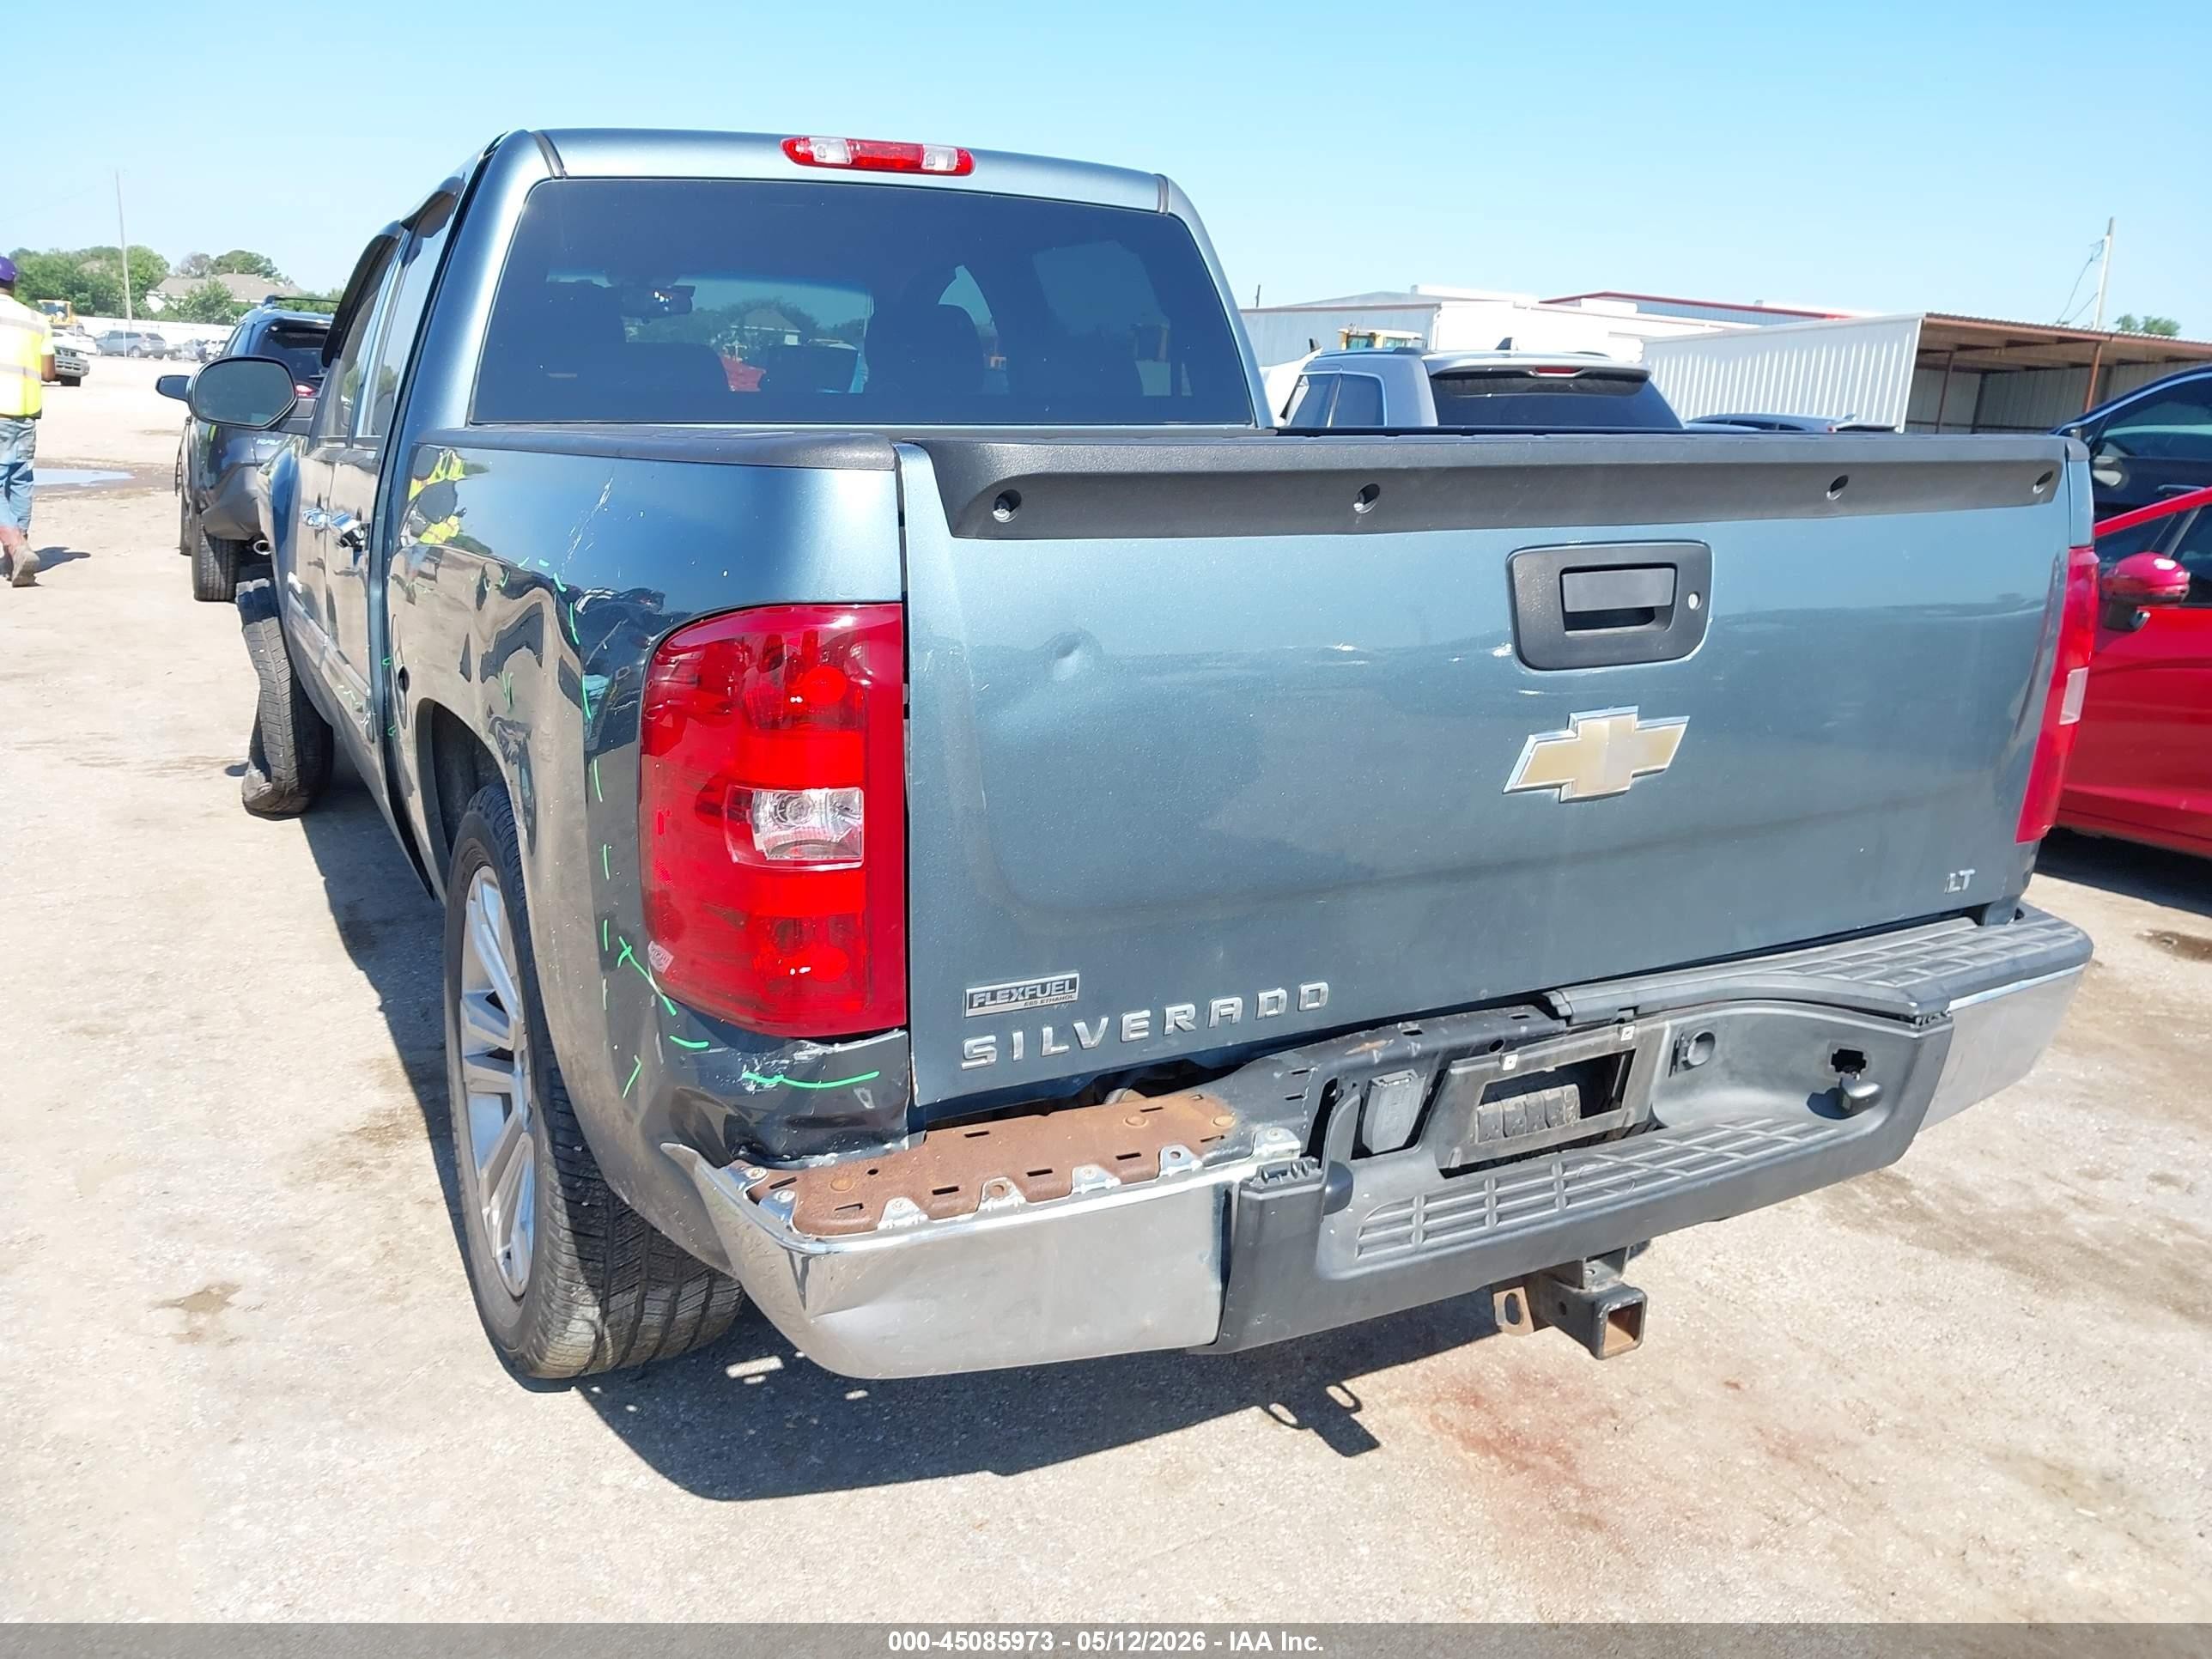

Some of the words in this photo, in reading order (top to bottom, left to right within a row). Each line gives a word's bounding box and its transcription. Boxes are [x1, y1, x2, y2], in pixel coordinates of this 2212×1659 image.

[1944, 868, 1976, 894] LT
[972, 979, 1075, 1008] FLEXFUEL
[1040, 994, 1074, 1005] ETHANOL
[961, 981, 1329, 1070] SILVERADO
